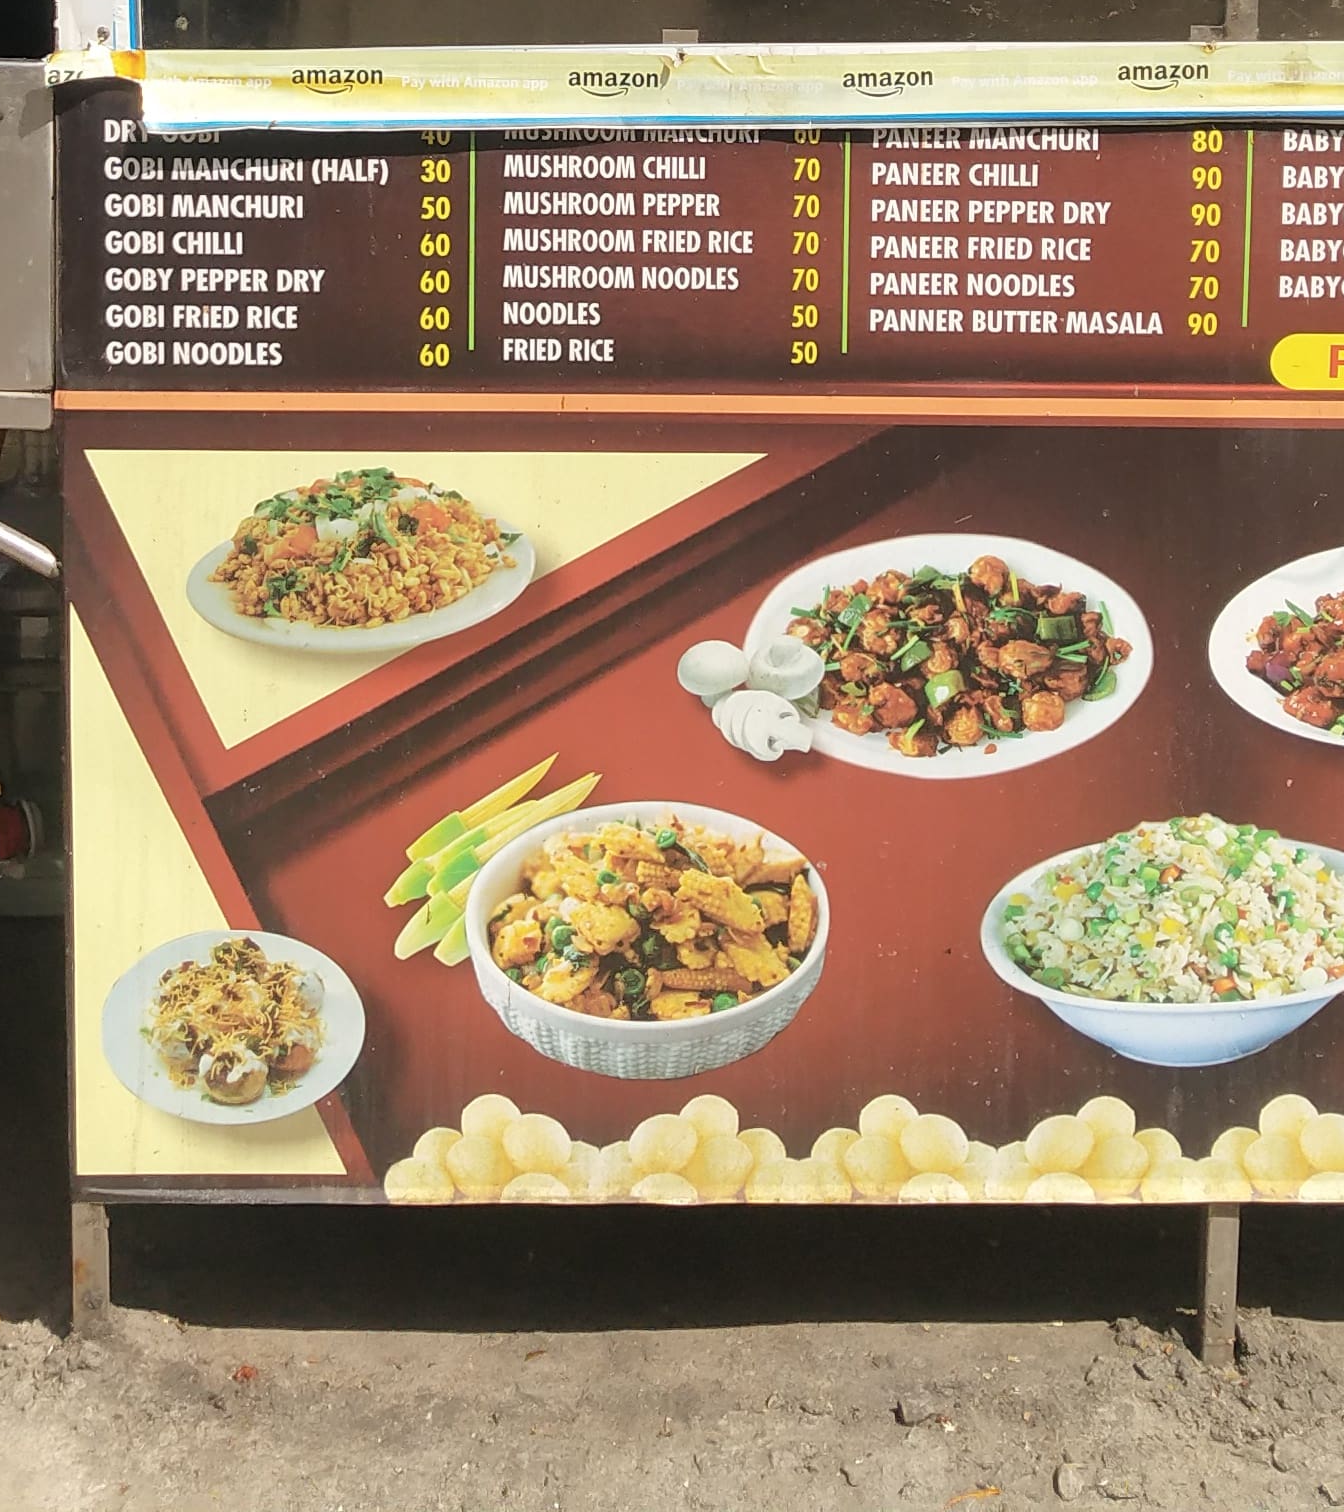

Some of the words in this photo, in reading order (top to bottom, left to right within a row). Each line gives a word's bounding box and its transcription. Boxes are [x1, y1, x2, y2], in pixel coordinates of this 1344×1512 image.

[292, 67, 384, 85] amazon
[569, 69, 659, 88] amazon
[843, 68, 934, 88] amazon
[1118, 61, 1210, 81] amazon
[872, 129, 960, 148] PANEER
[969, 130, 1099, 150] MANCHURI
[1192, 130, 1222, 152] 80
[104, 157, 163, 180] GOBI
[171, 158, 303, 181] MANCHURI
[312, 159, 388, 185] (HALF)
[421, 160, 450, 182] 30
[504, 155, 635, 178] MUSHROOM
[643, 157, 705, 179] CHILLI
[794, 159, 820, 180] 70
[873, 163, 960, 185] PANEER
[969, 164, 1038, 186] CHILLI
[1192, 167, 1221, 189] 90
[105, 194, 163, 217] GOBI
[172, 195, 303, 218] MANCHURI
[421, 197, 450, 219] 50
[504, 192, 635, 215] MUSHROOM
[643, 193, 719, 216] PEPPER
[794, 195, 819, 217] 70
[105, 231, 163, 254] GOBI
[173, 232, 242, 254] CHILLI
[421, 234, 450, 256] 60
[106, 268, 173, 291] GOBY
[182, 269, 268, 291] PEPPER
[277, 270, 325, 292] DRY
[421, 270, 449, 293] 60
[504, 302, 600, 325] NOODLES
[792, 305, 817, 327] 50
[870, 309, 963, 331] PANNER
[973, 310, 1057, 333] BUTTER
[1066, 312, 1163, 334] MASALA
[1188, 313, 1217, 335] 90
[504, 339, 561, 361] FRIED
[569, 339, 613, 361] RICE
[791, 342, 817, 363] 50
